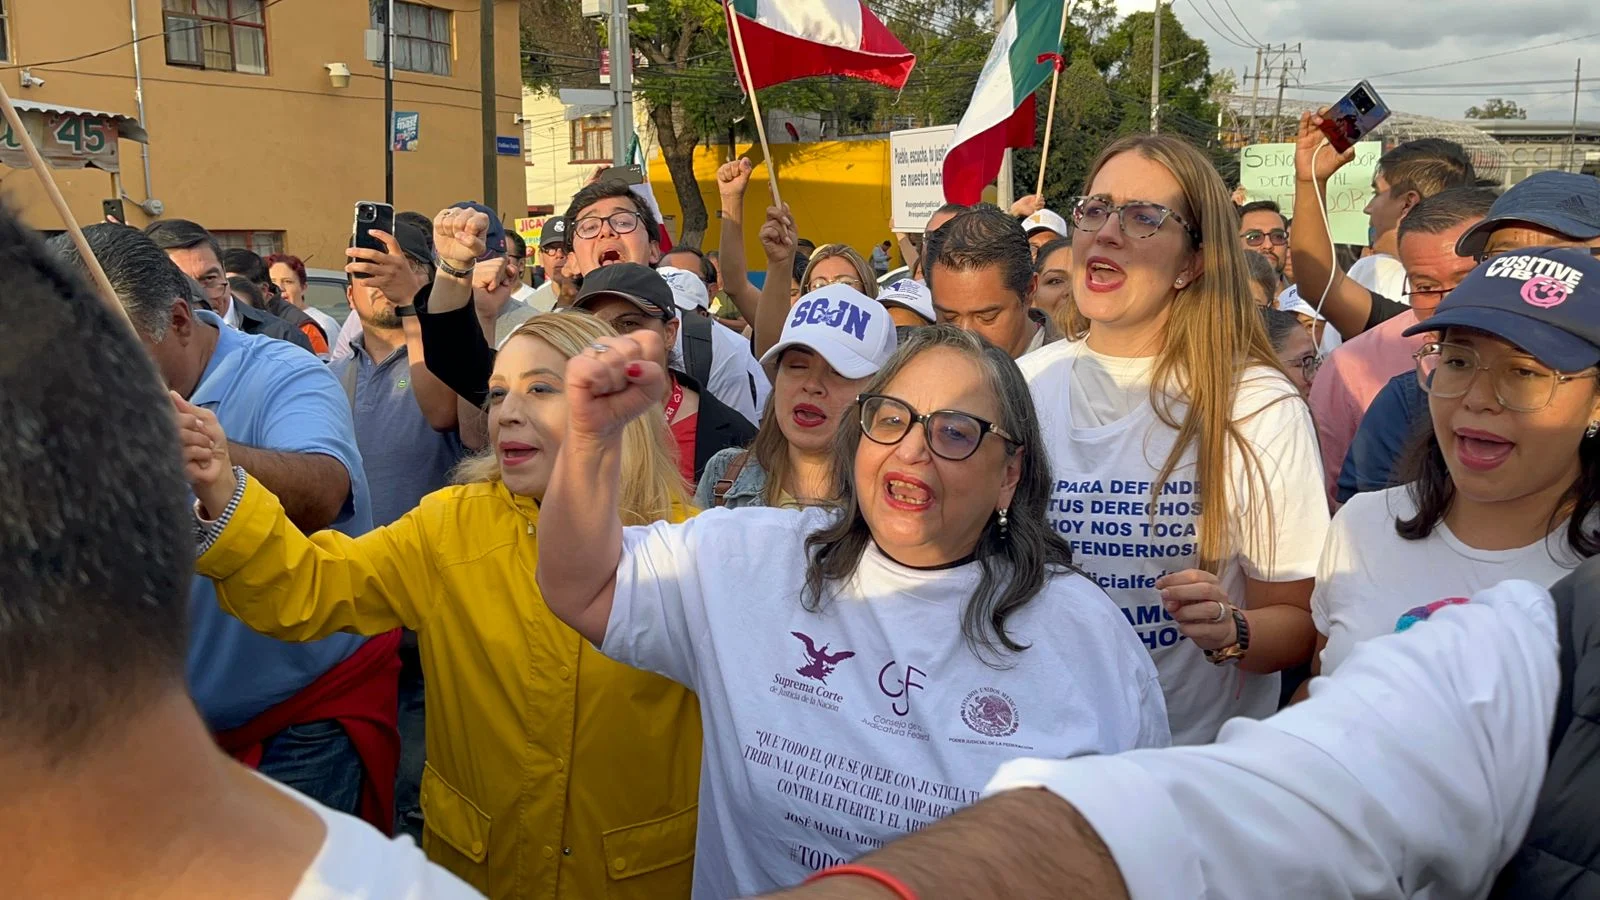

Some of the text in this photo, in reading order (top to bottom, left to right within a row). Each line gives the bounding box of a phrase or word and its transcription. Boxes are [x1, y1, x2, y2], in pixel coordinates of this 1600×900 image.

[907, 169, 929, 187] nuestra
[519, 218, 545, 233] JICA
[1486, 255, 1583, 286] POSITIVE
[790, 298, 871, 341] SCJN
[1048, 498, 1204, 516] TUS DERECHOS
[1091, 520, 1132, 537] NOS
[1139, 522, 1197, 538] TOCA
[769, 685, 778, 694] de
[777, 689, 801, 701] Justicia
[800, 693, 810, 703] de
[772, 672, 844, 704] Suprema Corte
[873, 714, 907, 729] Consejo
[744, 744, 794, 776] TRIBUNAL
[795, 763, 819, 783] QUE
[818, 770, 833, 786] LO
[884, 790, 900, 807] LO
[780, 737, 809, 758] TODO
[809, 747, 822, 764] EL
[823, 752, 847, 770] QUE
[846, 758, 861, 775] SE
[860, 763, 894, 784] QUEJE
[893, 771, 919, 791] CON
[917, 779, 967, 803] JUSTICIA
[777, 778, 820, 805] CONTRA
[821, 792, 835, 810] EL
[835, 796, 878, 823] FUERTE
[878, 809, 886, 825] Y
[887, 812, 901, 830] EL
[784, 811, 813, 828] JOSÉ
[812, 819, 851, 842] MARÍA
